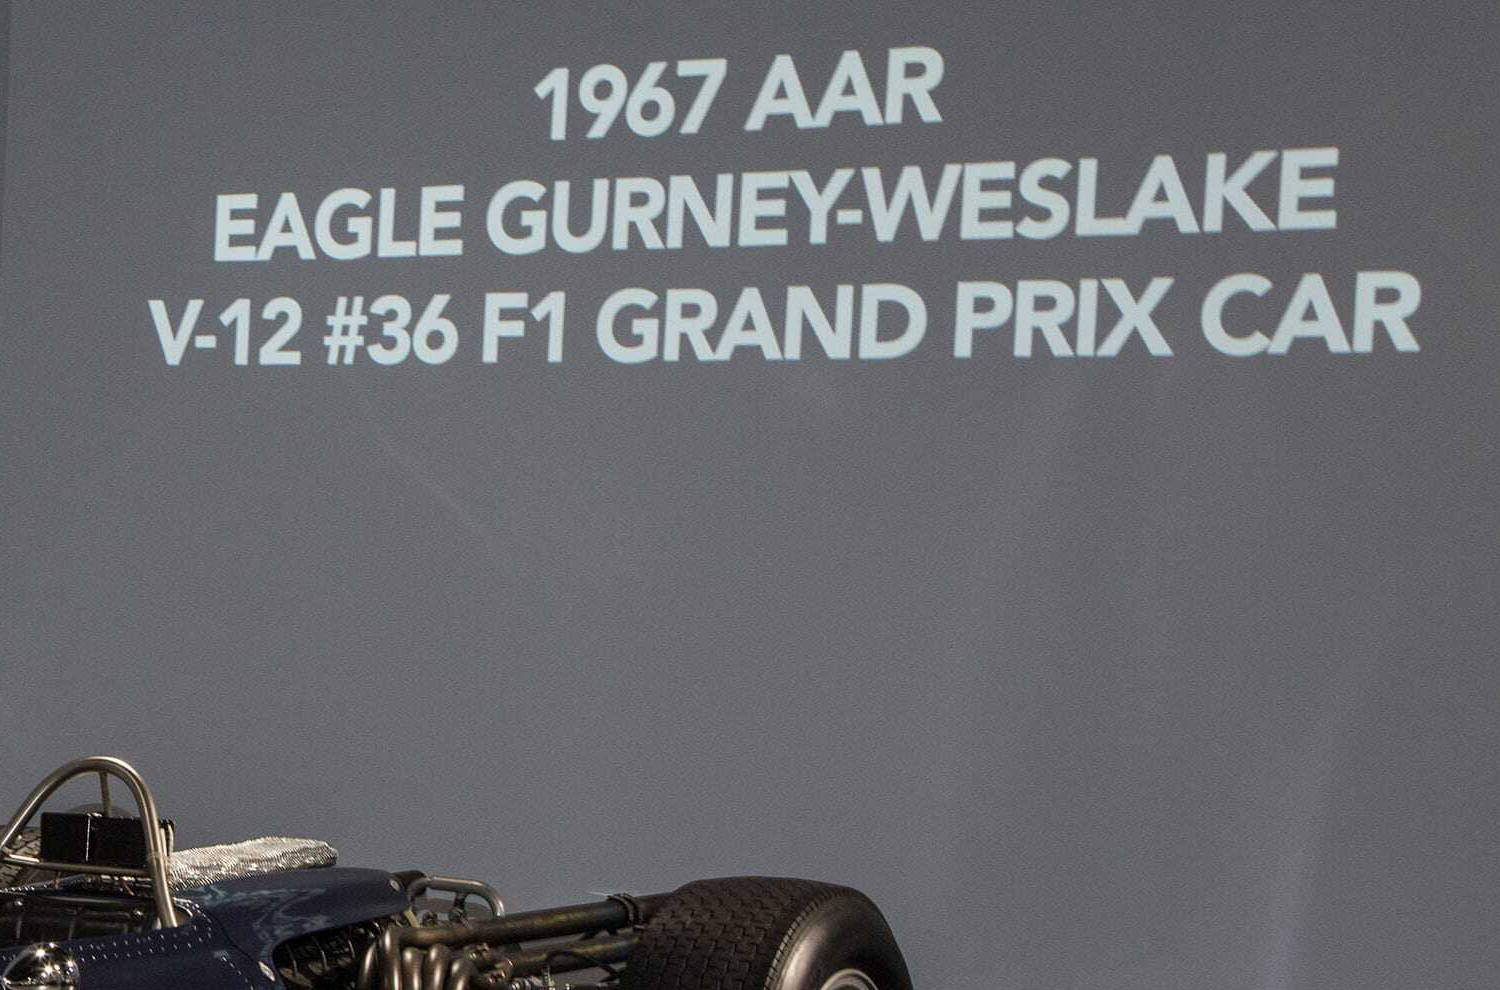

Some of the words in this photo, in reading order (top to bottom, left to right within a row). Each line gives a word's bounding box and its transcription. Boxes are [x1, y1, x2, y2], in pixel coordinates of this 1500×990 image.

[534, 58, 728, 141] 1967
[744, 46, 944, 131] AAR
[213, 184, 465, 262] EAGLE
[485, 147, 1339, 256] GURNEY-WESLAKE
[148, 296, 302, 366] V-12
[322, 293, 460, 366] #36
[481, 290, 566, 364] F1
[595, 282, 928, 364] GRAND
[953, 278, 1174, 358] PRIX
[1200, 271, 1422, 357] CAR
